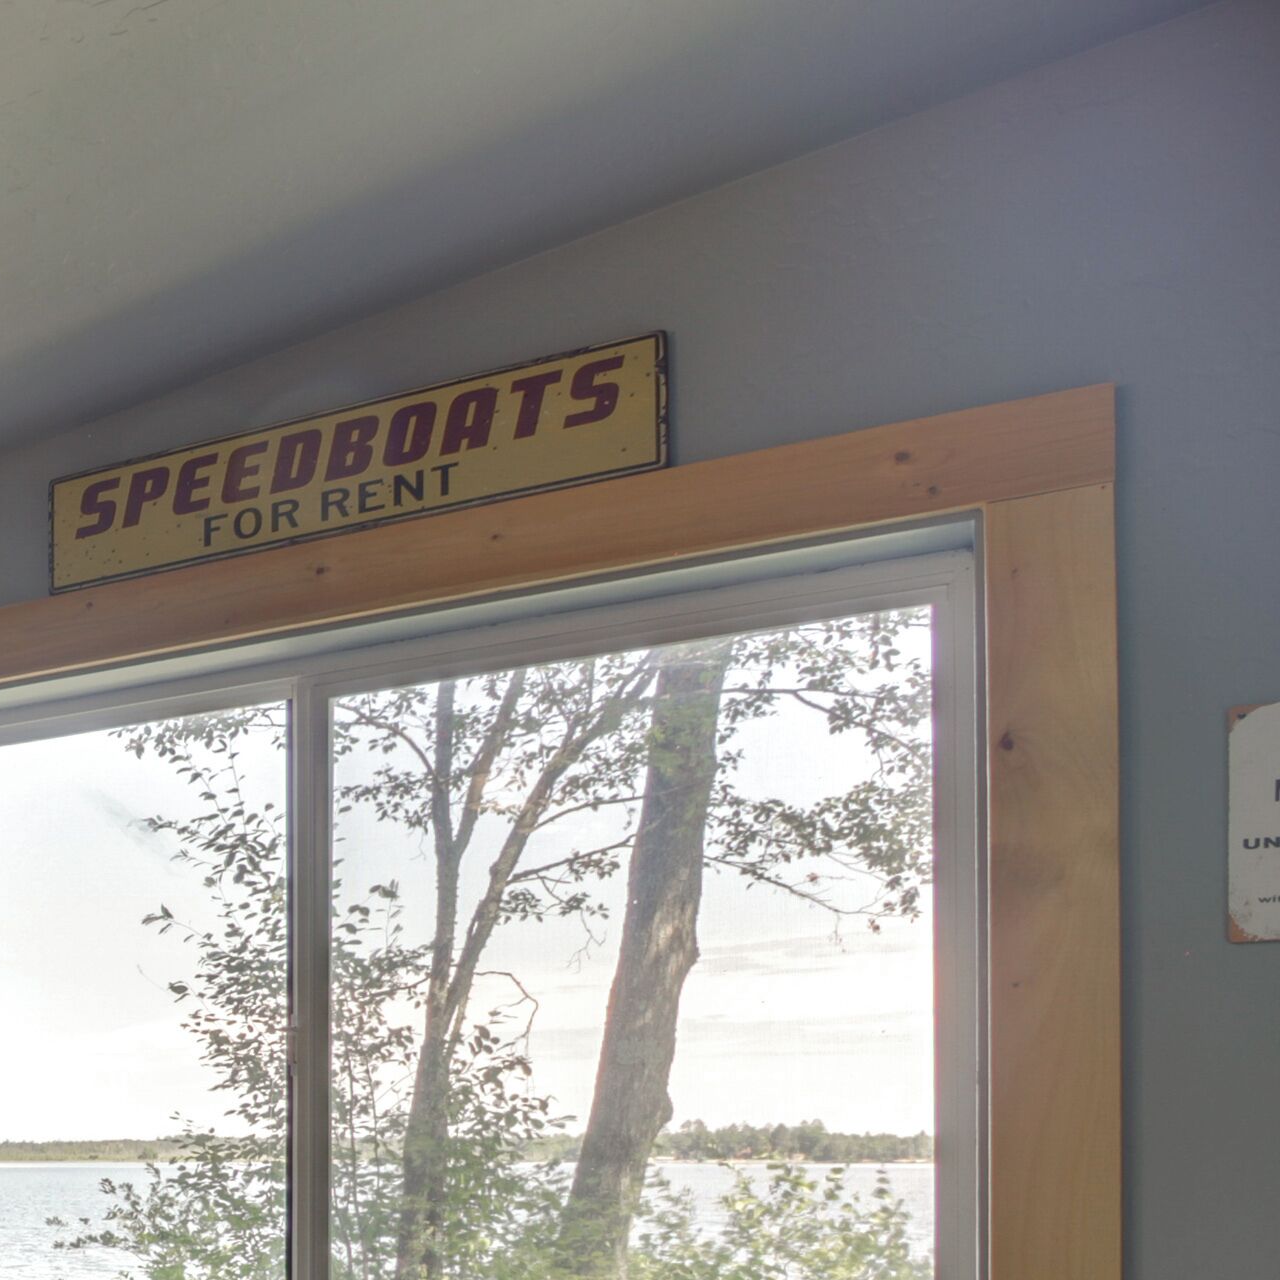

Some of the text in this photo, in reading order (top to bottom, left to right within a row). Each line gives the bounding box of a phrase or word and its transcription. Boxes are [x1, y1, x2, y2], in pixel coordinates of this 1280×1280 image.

[75, 354, 626, 541] SPEEDBOATS
[202, 462, 460, 547] FOR RENT
